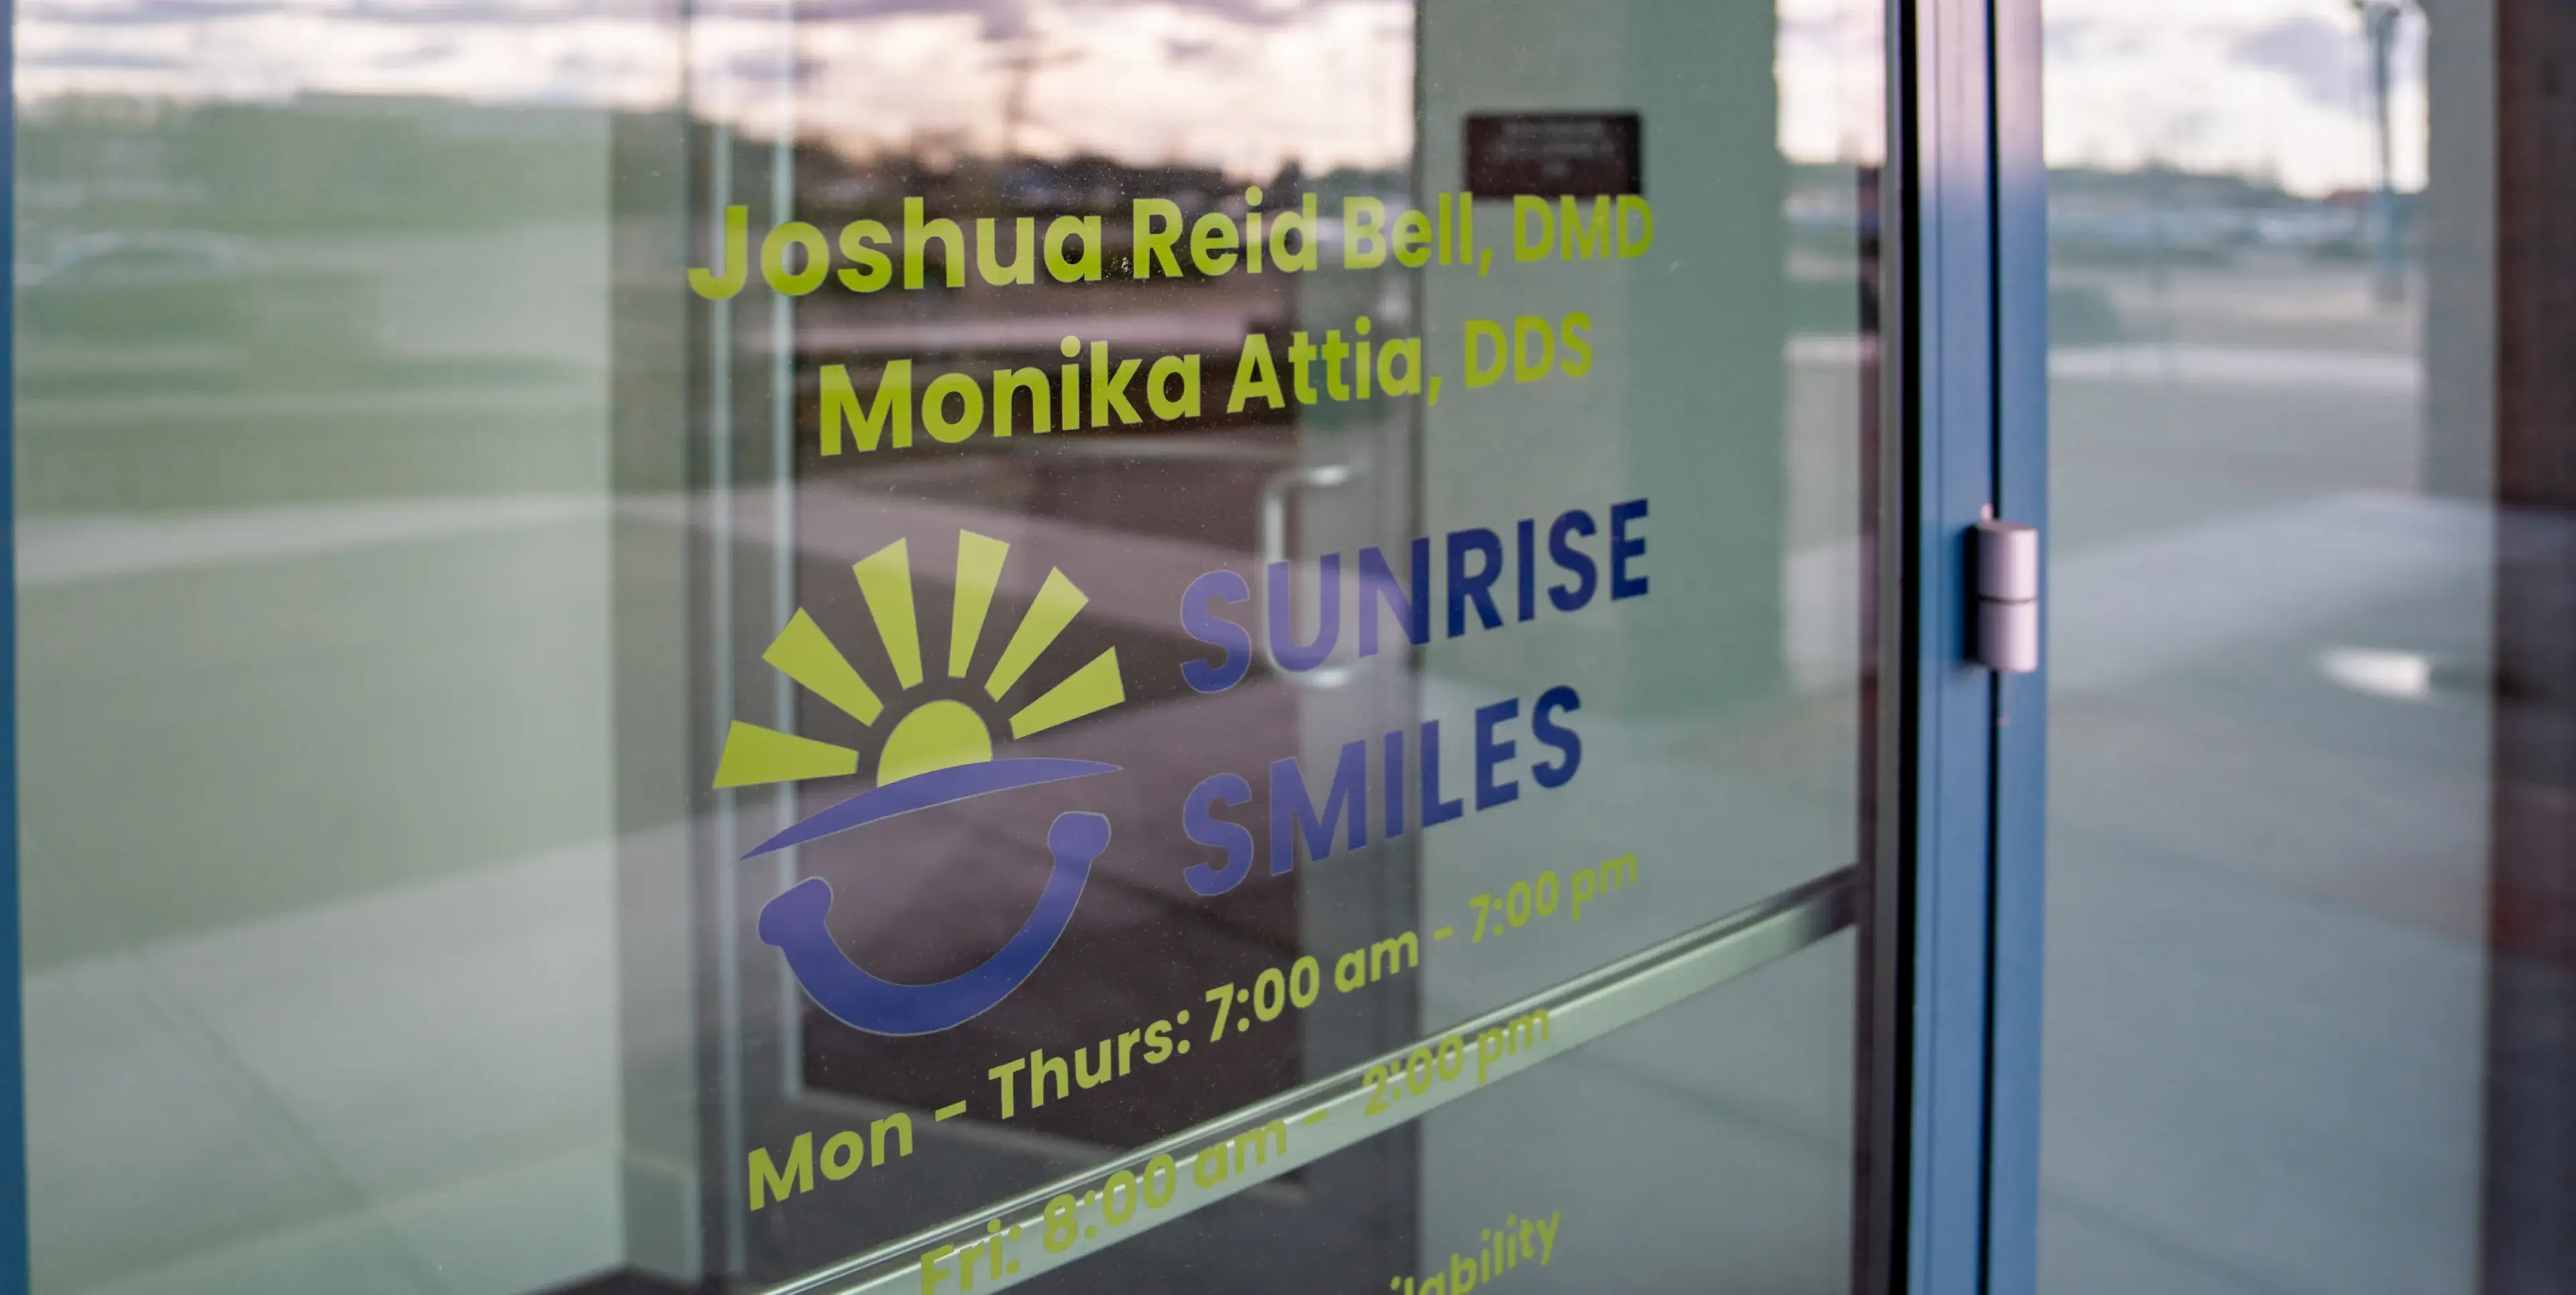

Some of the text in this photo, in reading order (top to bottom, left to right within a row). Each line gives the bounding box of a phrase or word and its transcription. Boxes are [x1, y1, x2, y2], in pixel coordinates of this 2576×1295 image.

[688, 185, 1655, 300] Joshua Reid Bell, DMD
[818, 311, 1593, 457] Monika Attia, DDS
[1180, 497, 1650, 694] SUNRISE
[1183, 684, 1583, 896] SMILES
[747, 1112, 913, 1211] Mon
[988, 1010, 1190, 1119] Thurs:
[1205, 955, 1320, 1042] 7:00
[1334, 931, 1419, 992] am
[1469, 870, 1559, 943] 7:00
[1572, 852, 1637, 921] pm
[920, 1216, 1022, 1295] Fri:
[1043, 1153, 1177, 1253] 8:00
[1193, 1120, 1287, 1188] am
[1362, 1035, 1464, 1118] 2:00
[1477, 1008, 1549, 1084] pm
